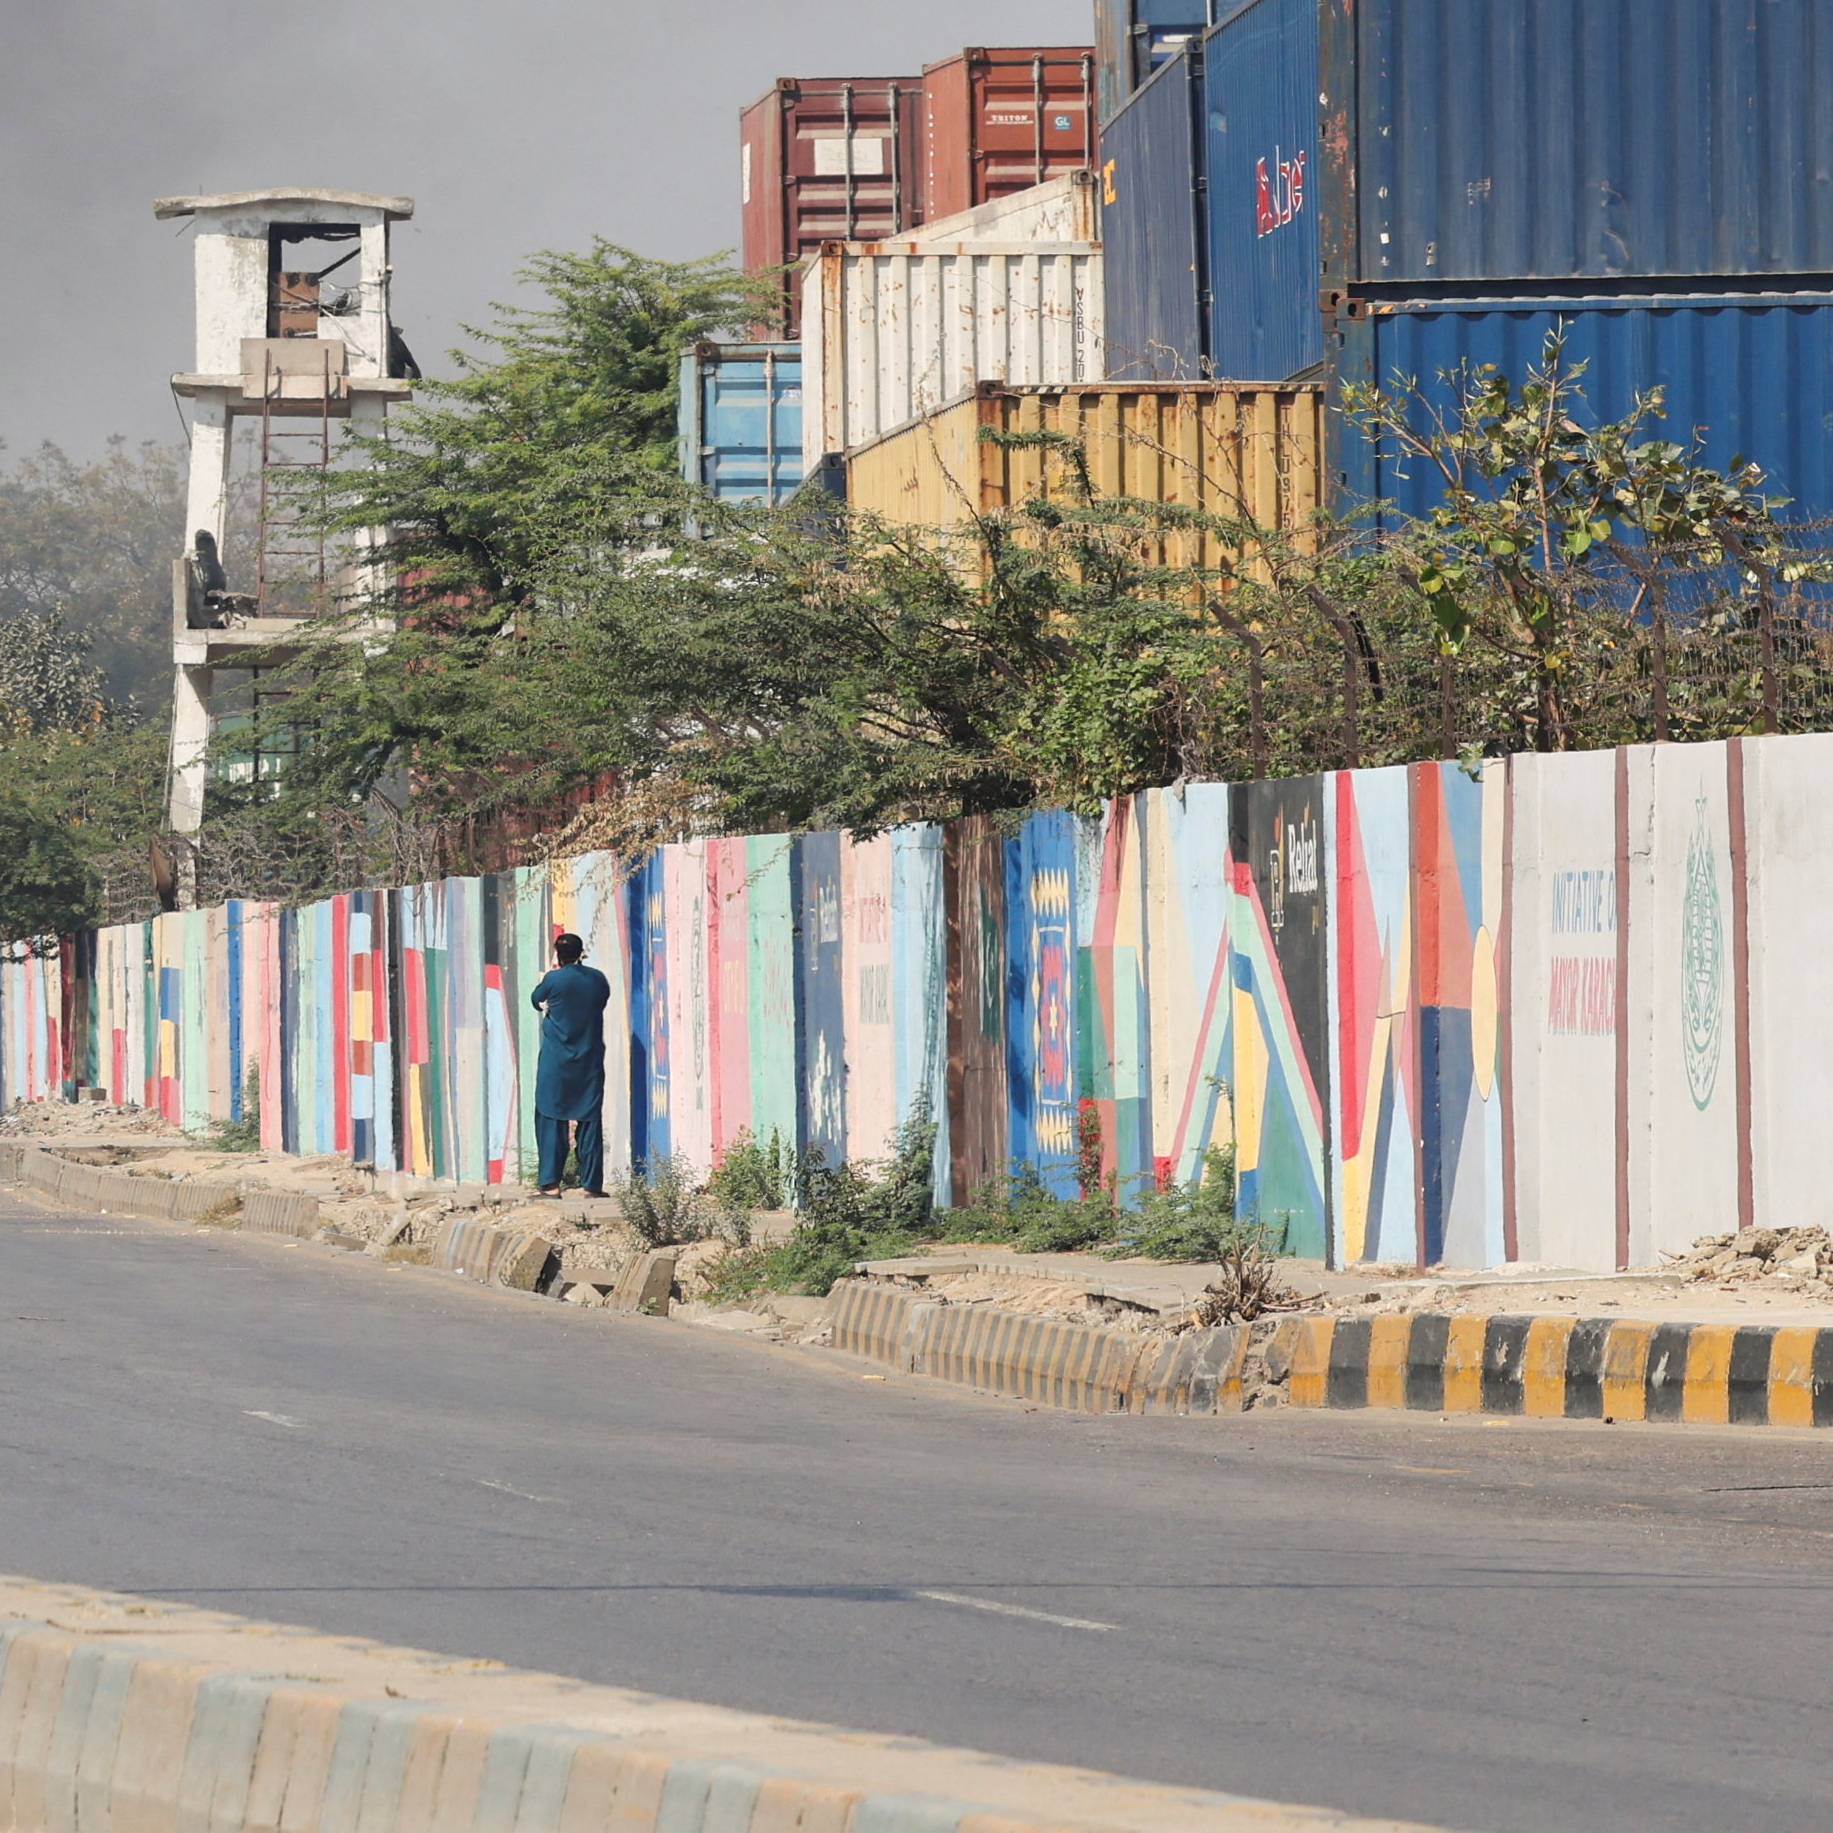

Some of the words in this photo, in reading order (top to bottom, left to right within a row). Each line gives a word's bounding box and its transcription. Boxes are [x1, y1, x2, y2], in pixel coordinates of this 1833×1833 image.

[990, 114, 1029, 122] TRITON
[1077, 349, 1086, 383] 20
[1551, 870, 1605, 934] INITIATIVE
[1607, 870, 1617, 934] O
